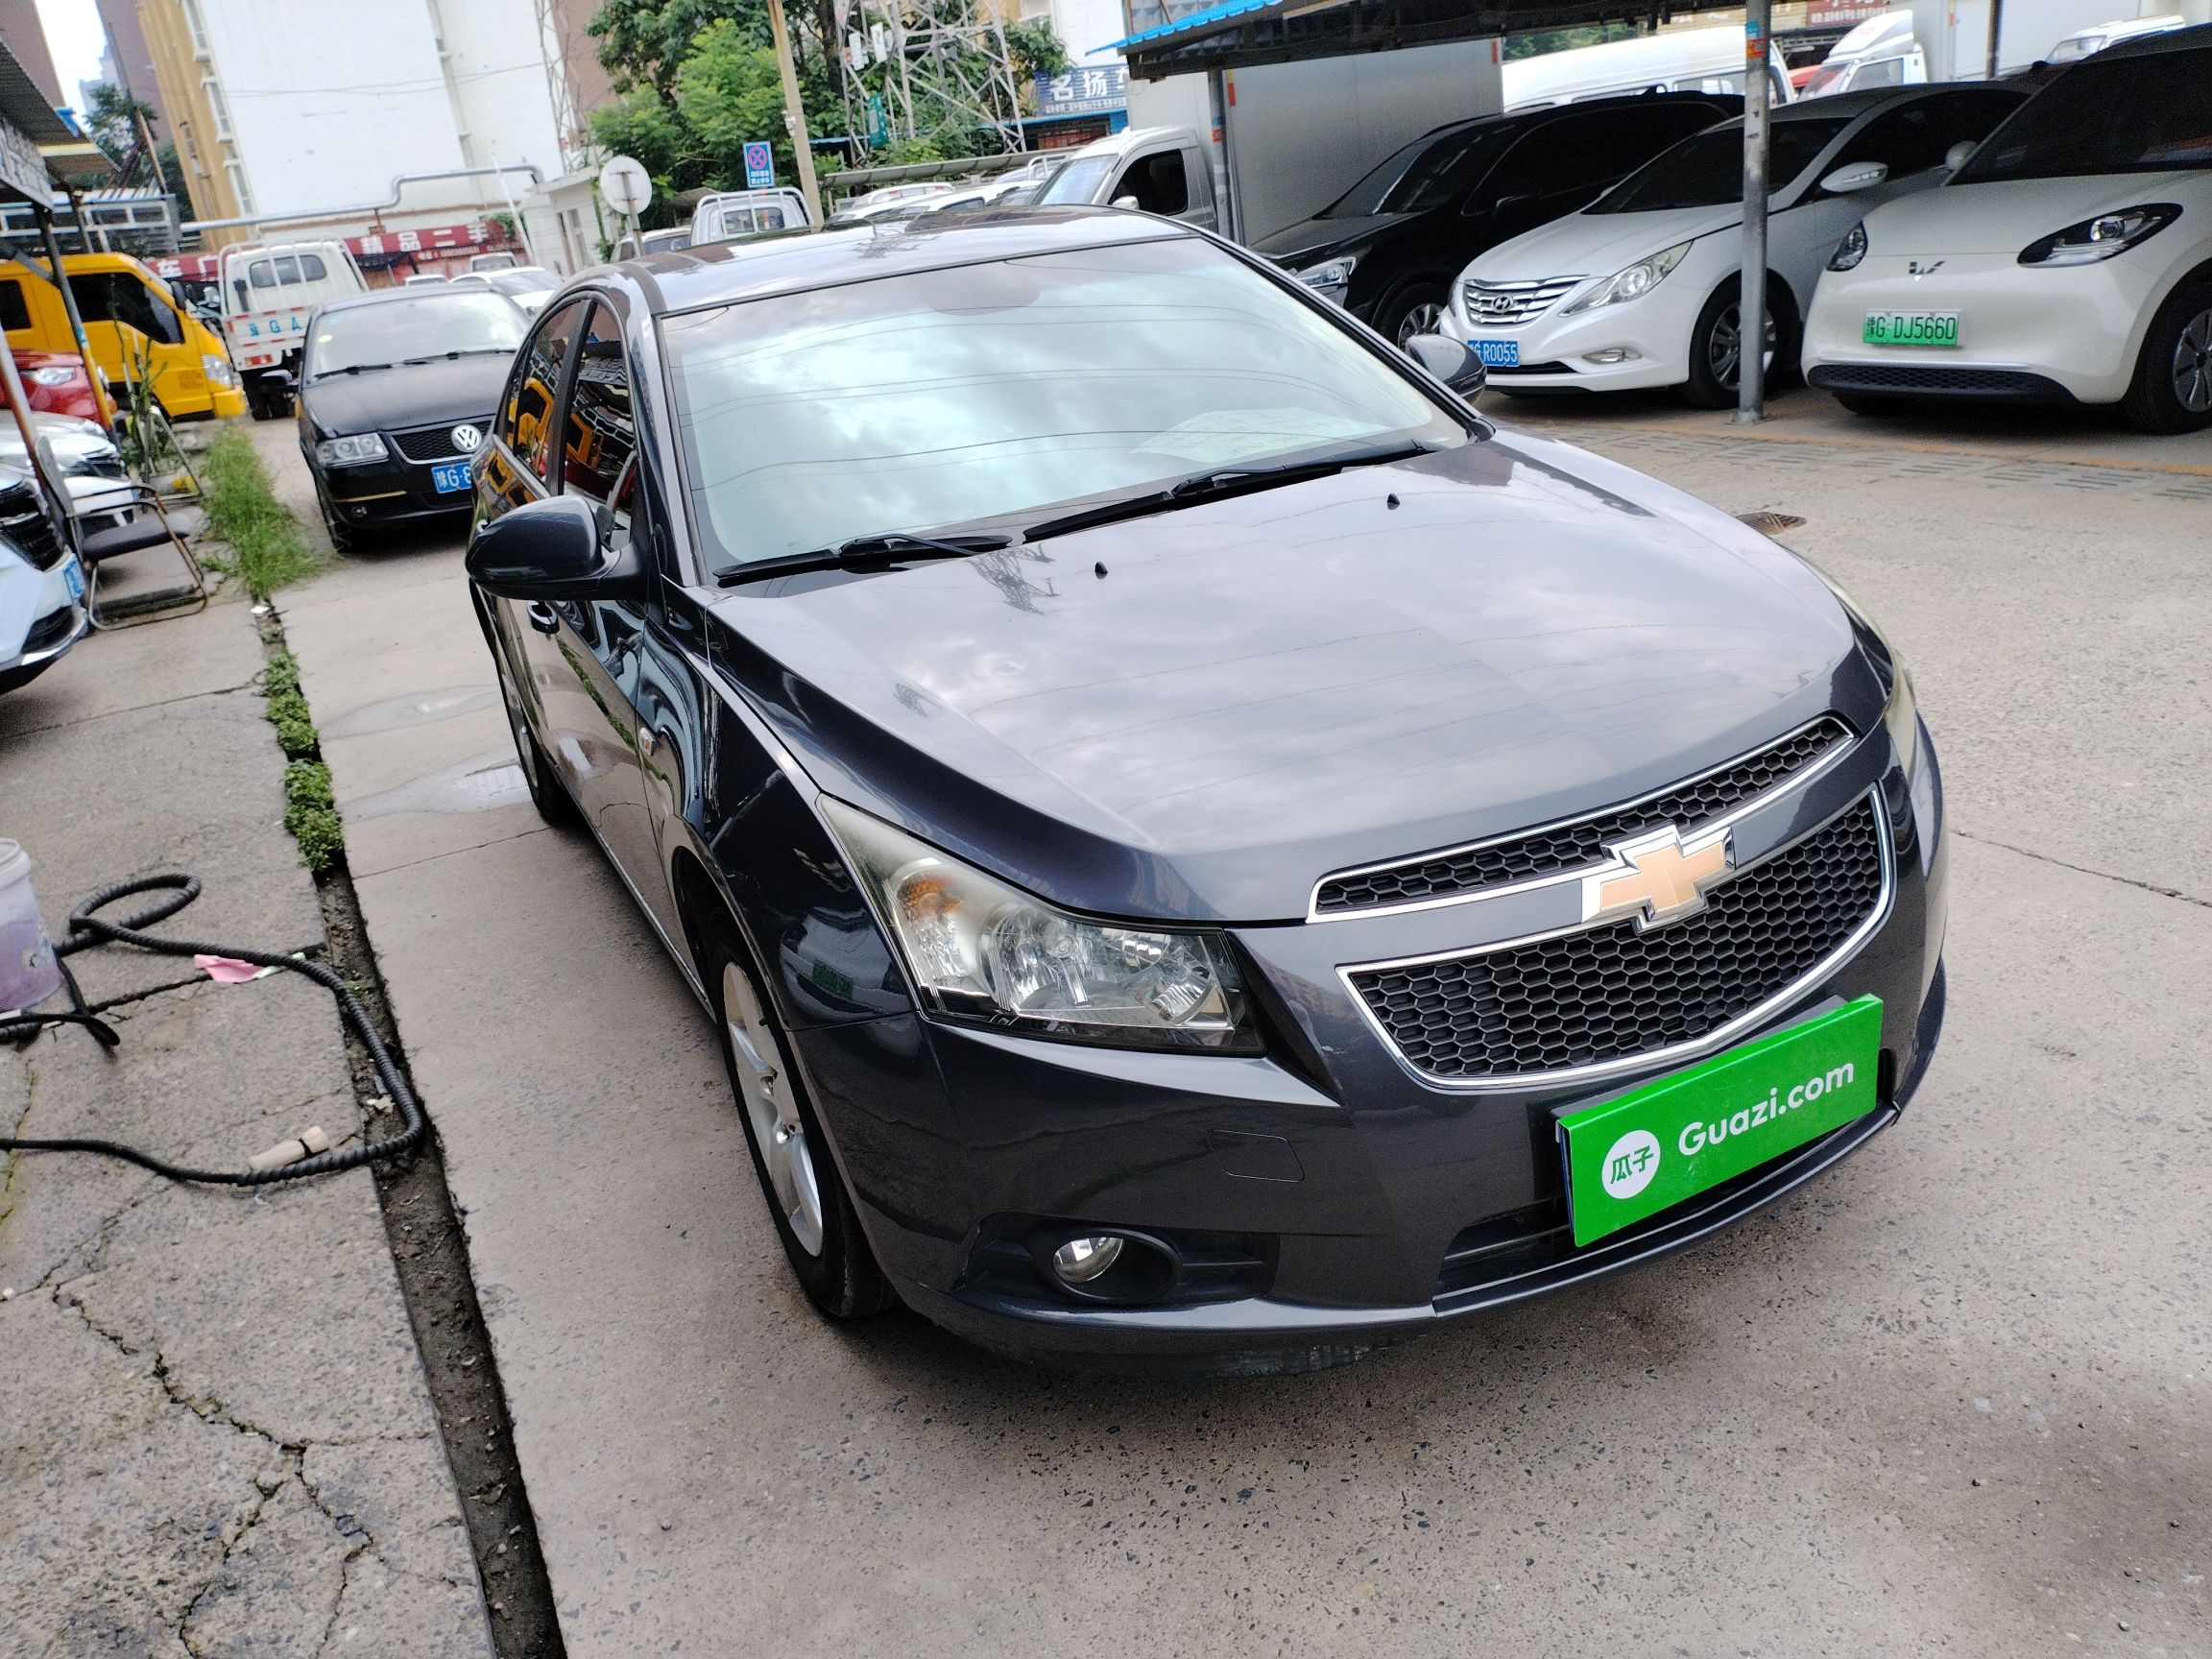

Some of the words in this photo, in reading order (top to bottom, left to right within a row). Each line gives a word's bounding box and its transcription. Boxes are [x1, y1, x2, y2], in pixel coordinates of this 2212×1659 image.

[360, 222, 488, 254] 精品二手
[1678, 1062, 1854, 1156] Guazi.com
[1610, 1145, 1654, 1185] 瓜子
